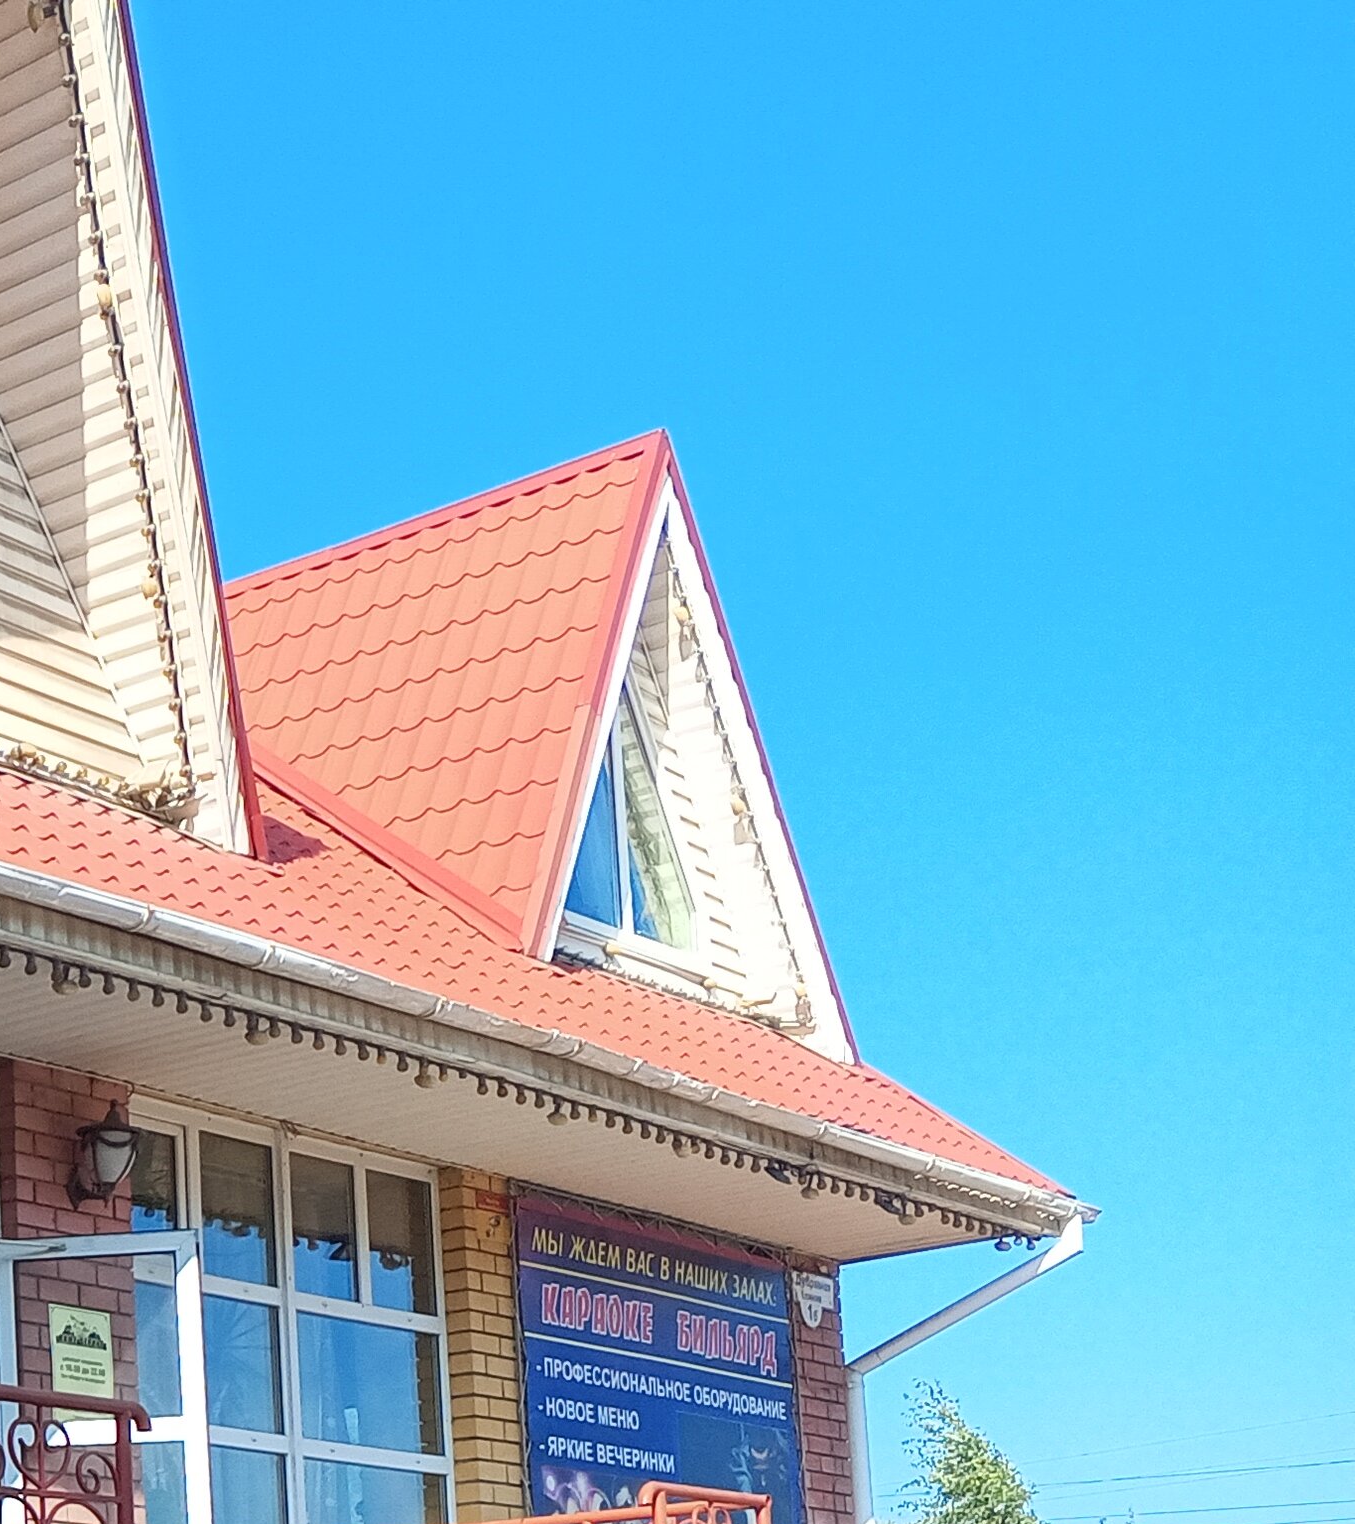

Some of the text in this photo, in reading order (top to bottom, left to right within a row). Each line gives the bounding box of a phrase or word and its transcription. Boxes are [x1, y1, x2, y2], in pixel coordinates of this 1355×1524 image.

[532, 1226, 564, 1257] МЫ
[569, 1234, 621, 1270] ЖДЕМ
[626, 1248, 655, 1277] ВАС
[660, 1256, 670, 1281] В
[675, 1260, 728, 1296] НАШИХ
[541, 1283, 778, 1378] КАРАОКЕ БИЛЬЯРД
[544, 1357, 788, 1421] ПРОФЕССИОНАЛЬНОЕ ОБОРУДОВАНИЕ
[545, 1396, 640, 1430] НОВОЕ МЕНЮ
[547, 1436, 676, 1475] ЯРКИЕ ВЕЧЕРИНКИ
